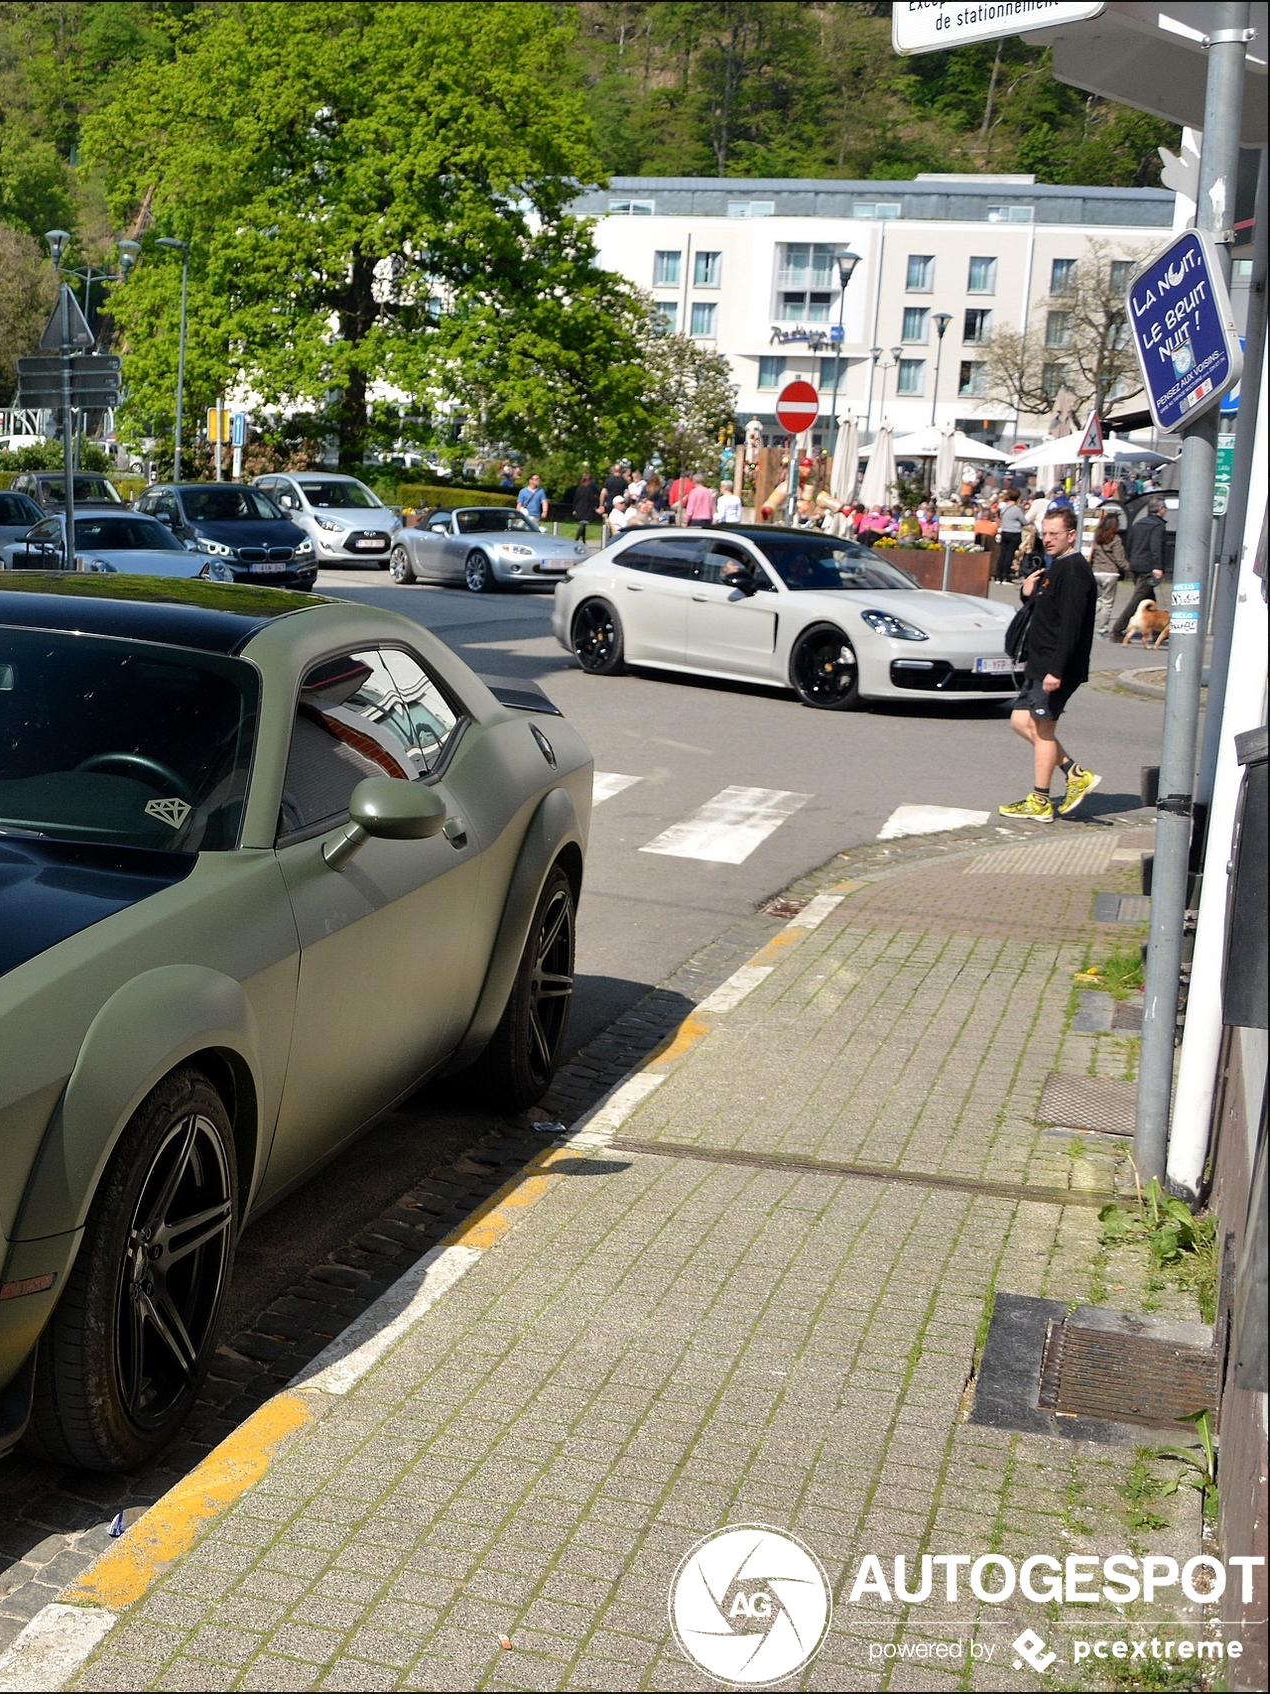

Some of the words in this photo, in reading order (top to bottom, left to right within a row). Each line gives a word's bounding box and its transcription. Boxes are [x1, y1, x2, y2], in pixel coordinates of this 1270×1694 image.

[936, 13, 951, 31] de
[957, 2, 1058, 26] stationneme
[1133, 289, 1156, 317] LA
[1143, 322, 1163, 349] LE
[1165, 281, 1205, 330] BRUIT
[1158, 321, 1190, 362] NUIT
[1156, 383, 1181, 408] PENSEZ
[1180, 371, 1194, 388] AUX
